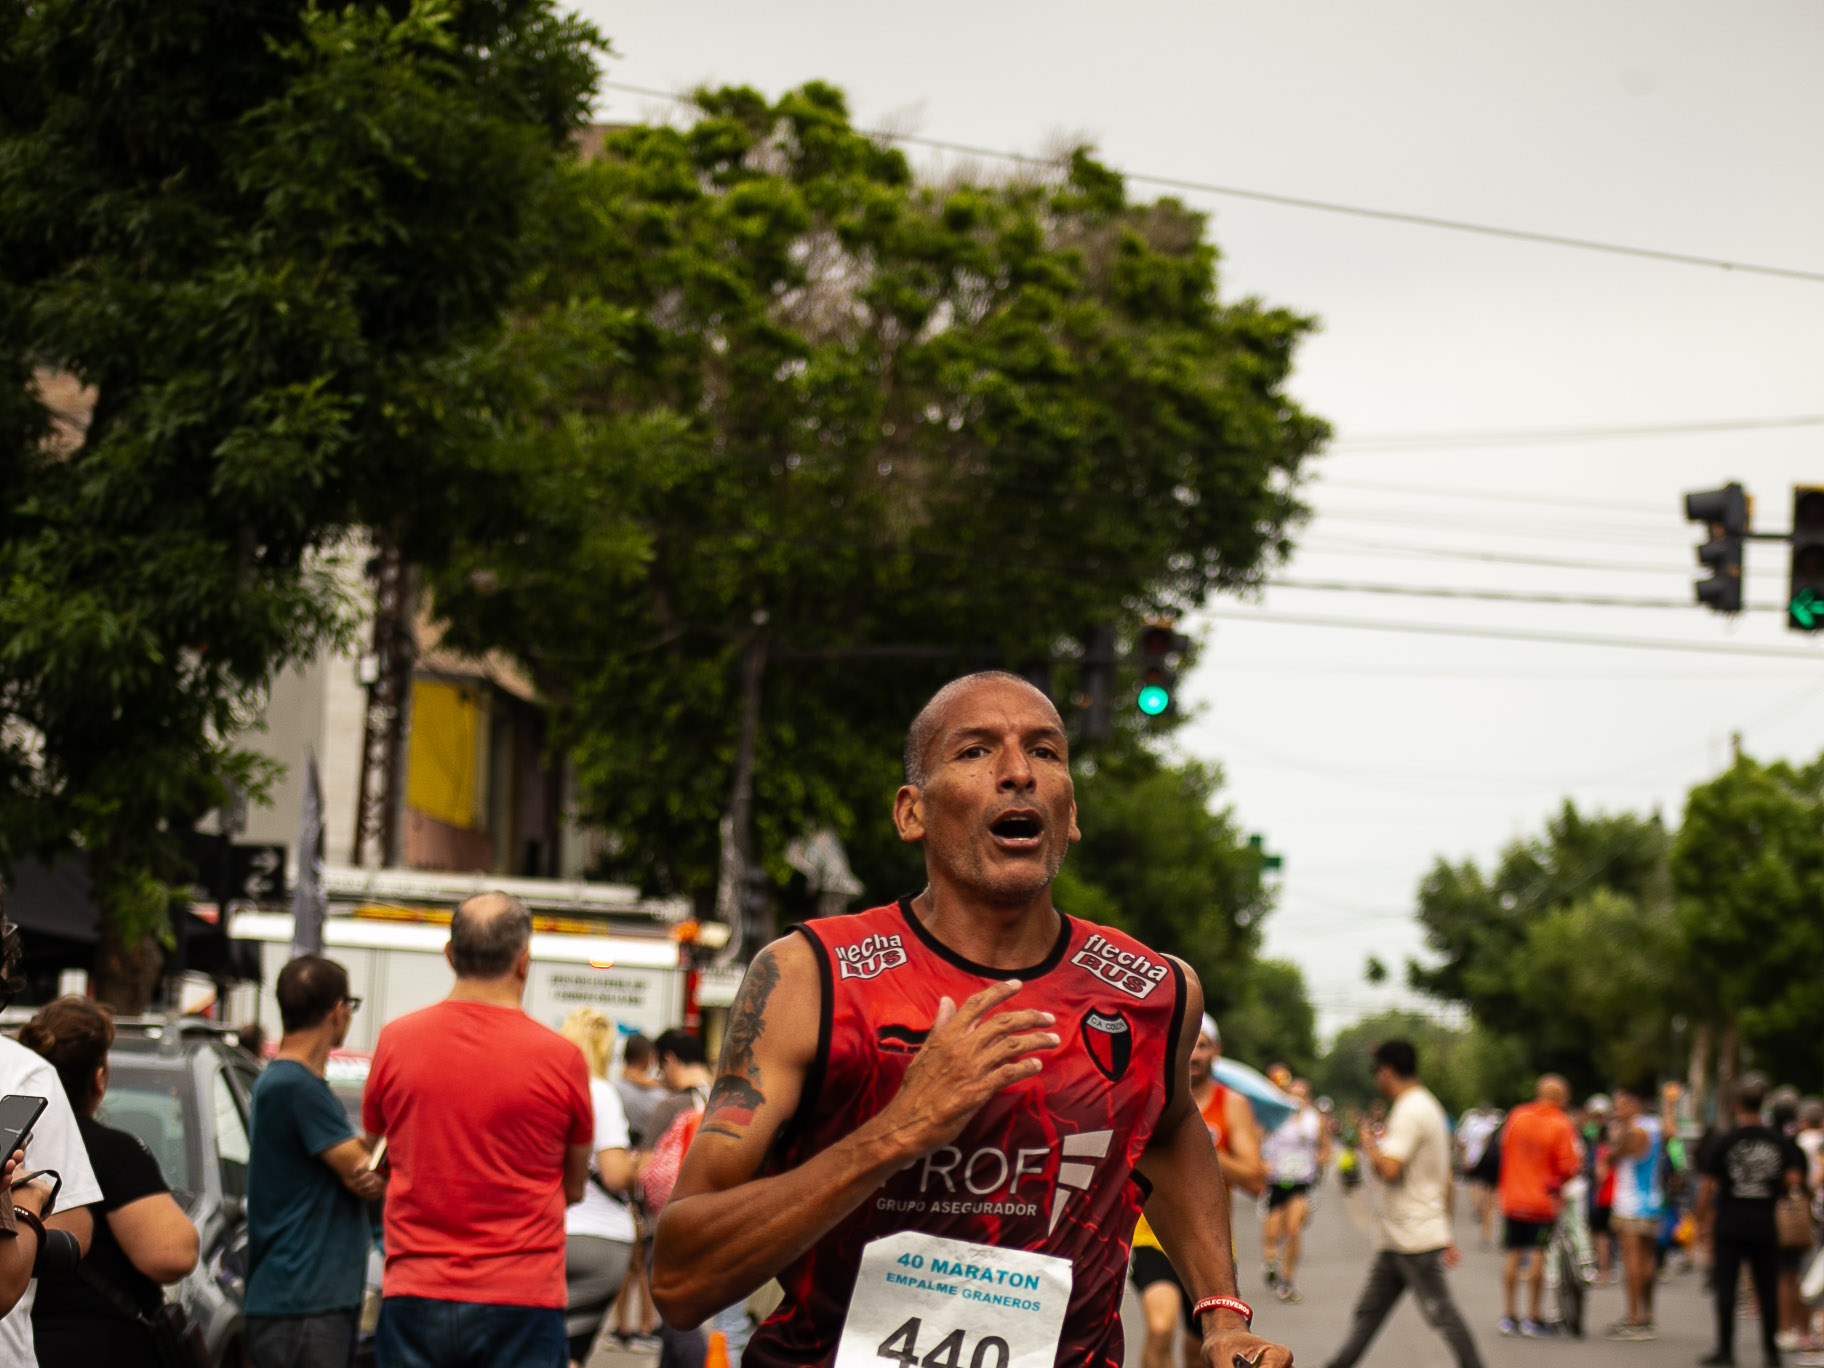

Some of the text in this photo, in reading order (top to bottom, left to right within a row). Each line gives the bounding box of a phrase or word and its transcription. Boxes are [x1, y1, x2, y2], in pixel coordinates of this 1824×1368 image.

[1077, 953, 1147, 993] BUS
[1083, 934, 1168, 981] flecha
[876, 1198, 1037, 1216] GRUPO ASEGURADOR
[897, 1252, 1040, 1291] 40 MARATON
[886, 1272, 1041, 1312] EMPALME GRANEROS
[1200, 1298, 1250, 1315] COLECTIVEROS
